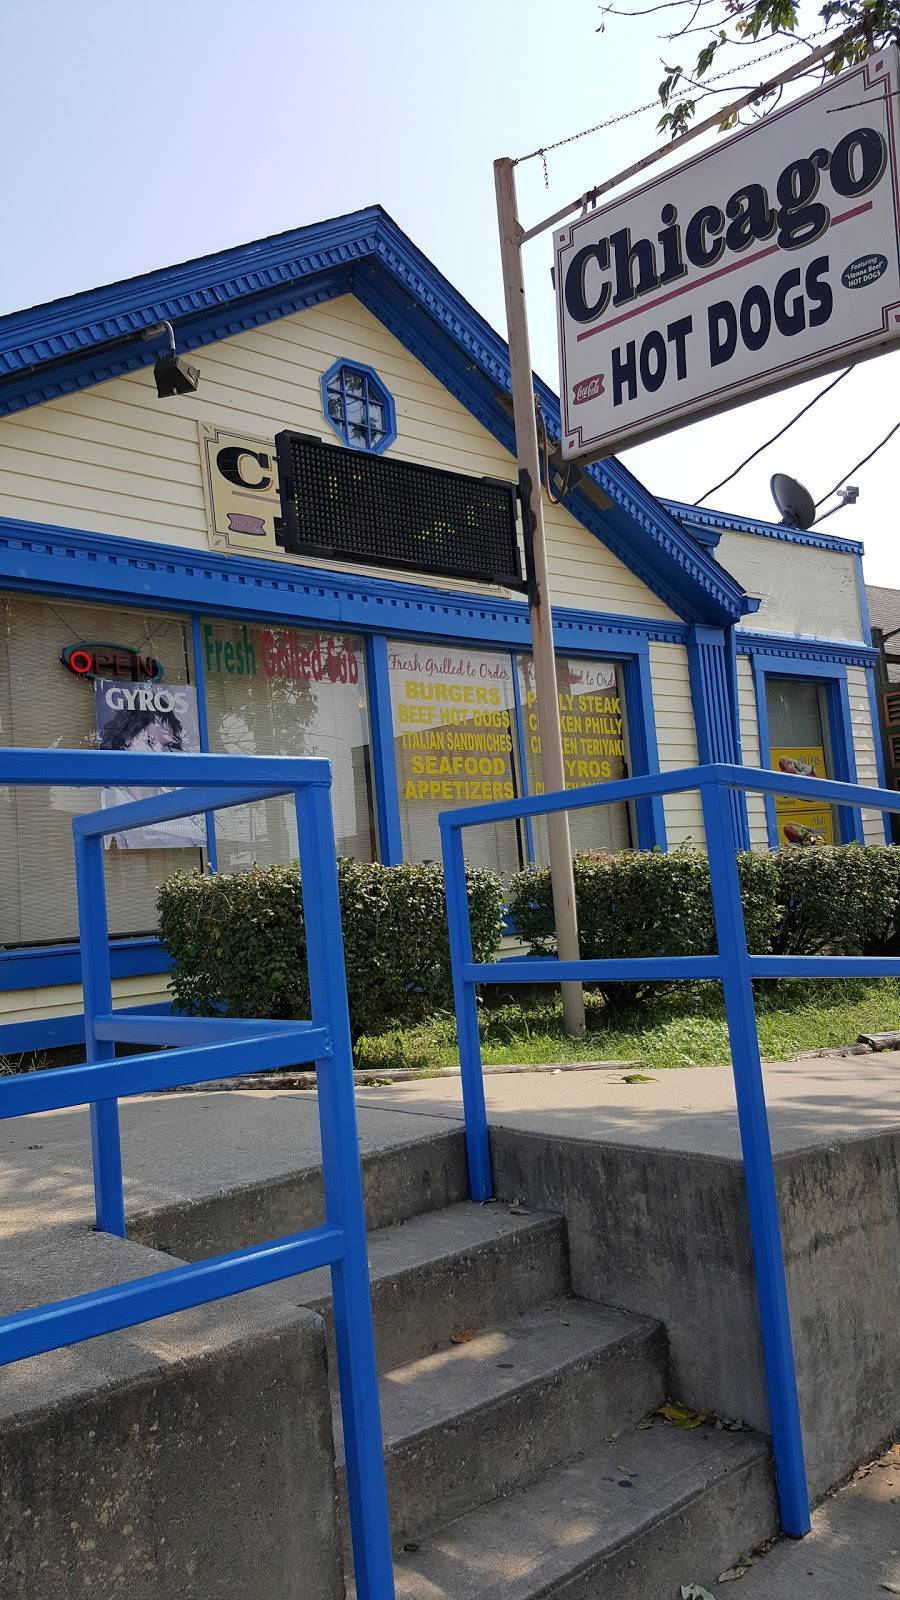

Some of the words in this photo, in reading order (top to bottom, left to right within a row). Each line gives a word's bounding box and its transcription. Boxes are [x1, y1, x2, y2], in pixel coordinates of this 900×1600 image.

[565, 127, 887, 324] Chicago
[850, 257, 878, 271] Featuring
[848, 276, 862, 288] HOT
[863, 269, 881, 282] DOGS
[611, 314, 693, 407] HOT
[707, 255, 834, 368] DOGS
[69, 649, 155, 679] OPEN
[204, 624, 257, 676] Fresh
[260, 630, 325, 683] Grilled
[389, 653, 422, 672] Fresh
[425, 657, 465, 677] Grilled
[467, 661, 476, 677] to
[479, 663, 511, 680] Order
[105, 687, 189, 714] GYROS
[405, 680, 501, 705] BURGERS
[578, 695, 621, 714] STEAK
[399, 704, 436, 724] BEEF
[440, 706, 470, 728] HOT
[473, 709, 510, 728] DOGS
[585, 716, 623, 735] PHILLY
[402, 730, 445, 750] ITALIAN
[446, 731, 512, 752] SANDWICHES
[580, 738, 624, 756] TERIYAKI
[411, 755, 505, 776] SEAFOOD
[565, 760, 611, 778] YROS
[405, 780, 514, 800] APPETIZERS
